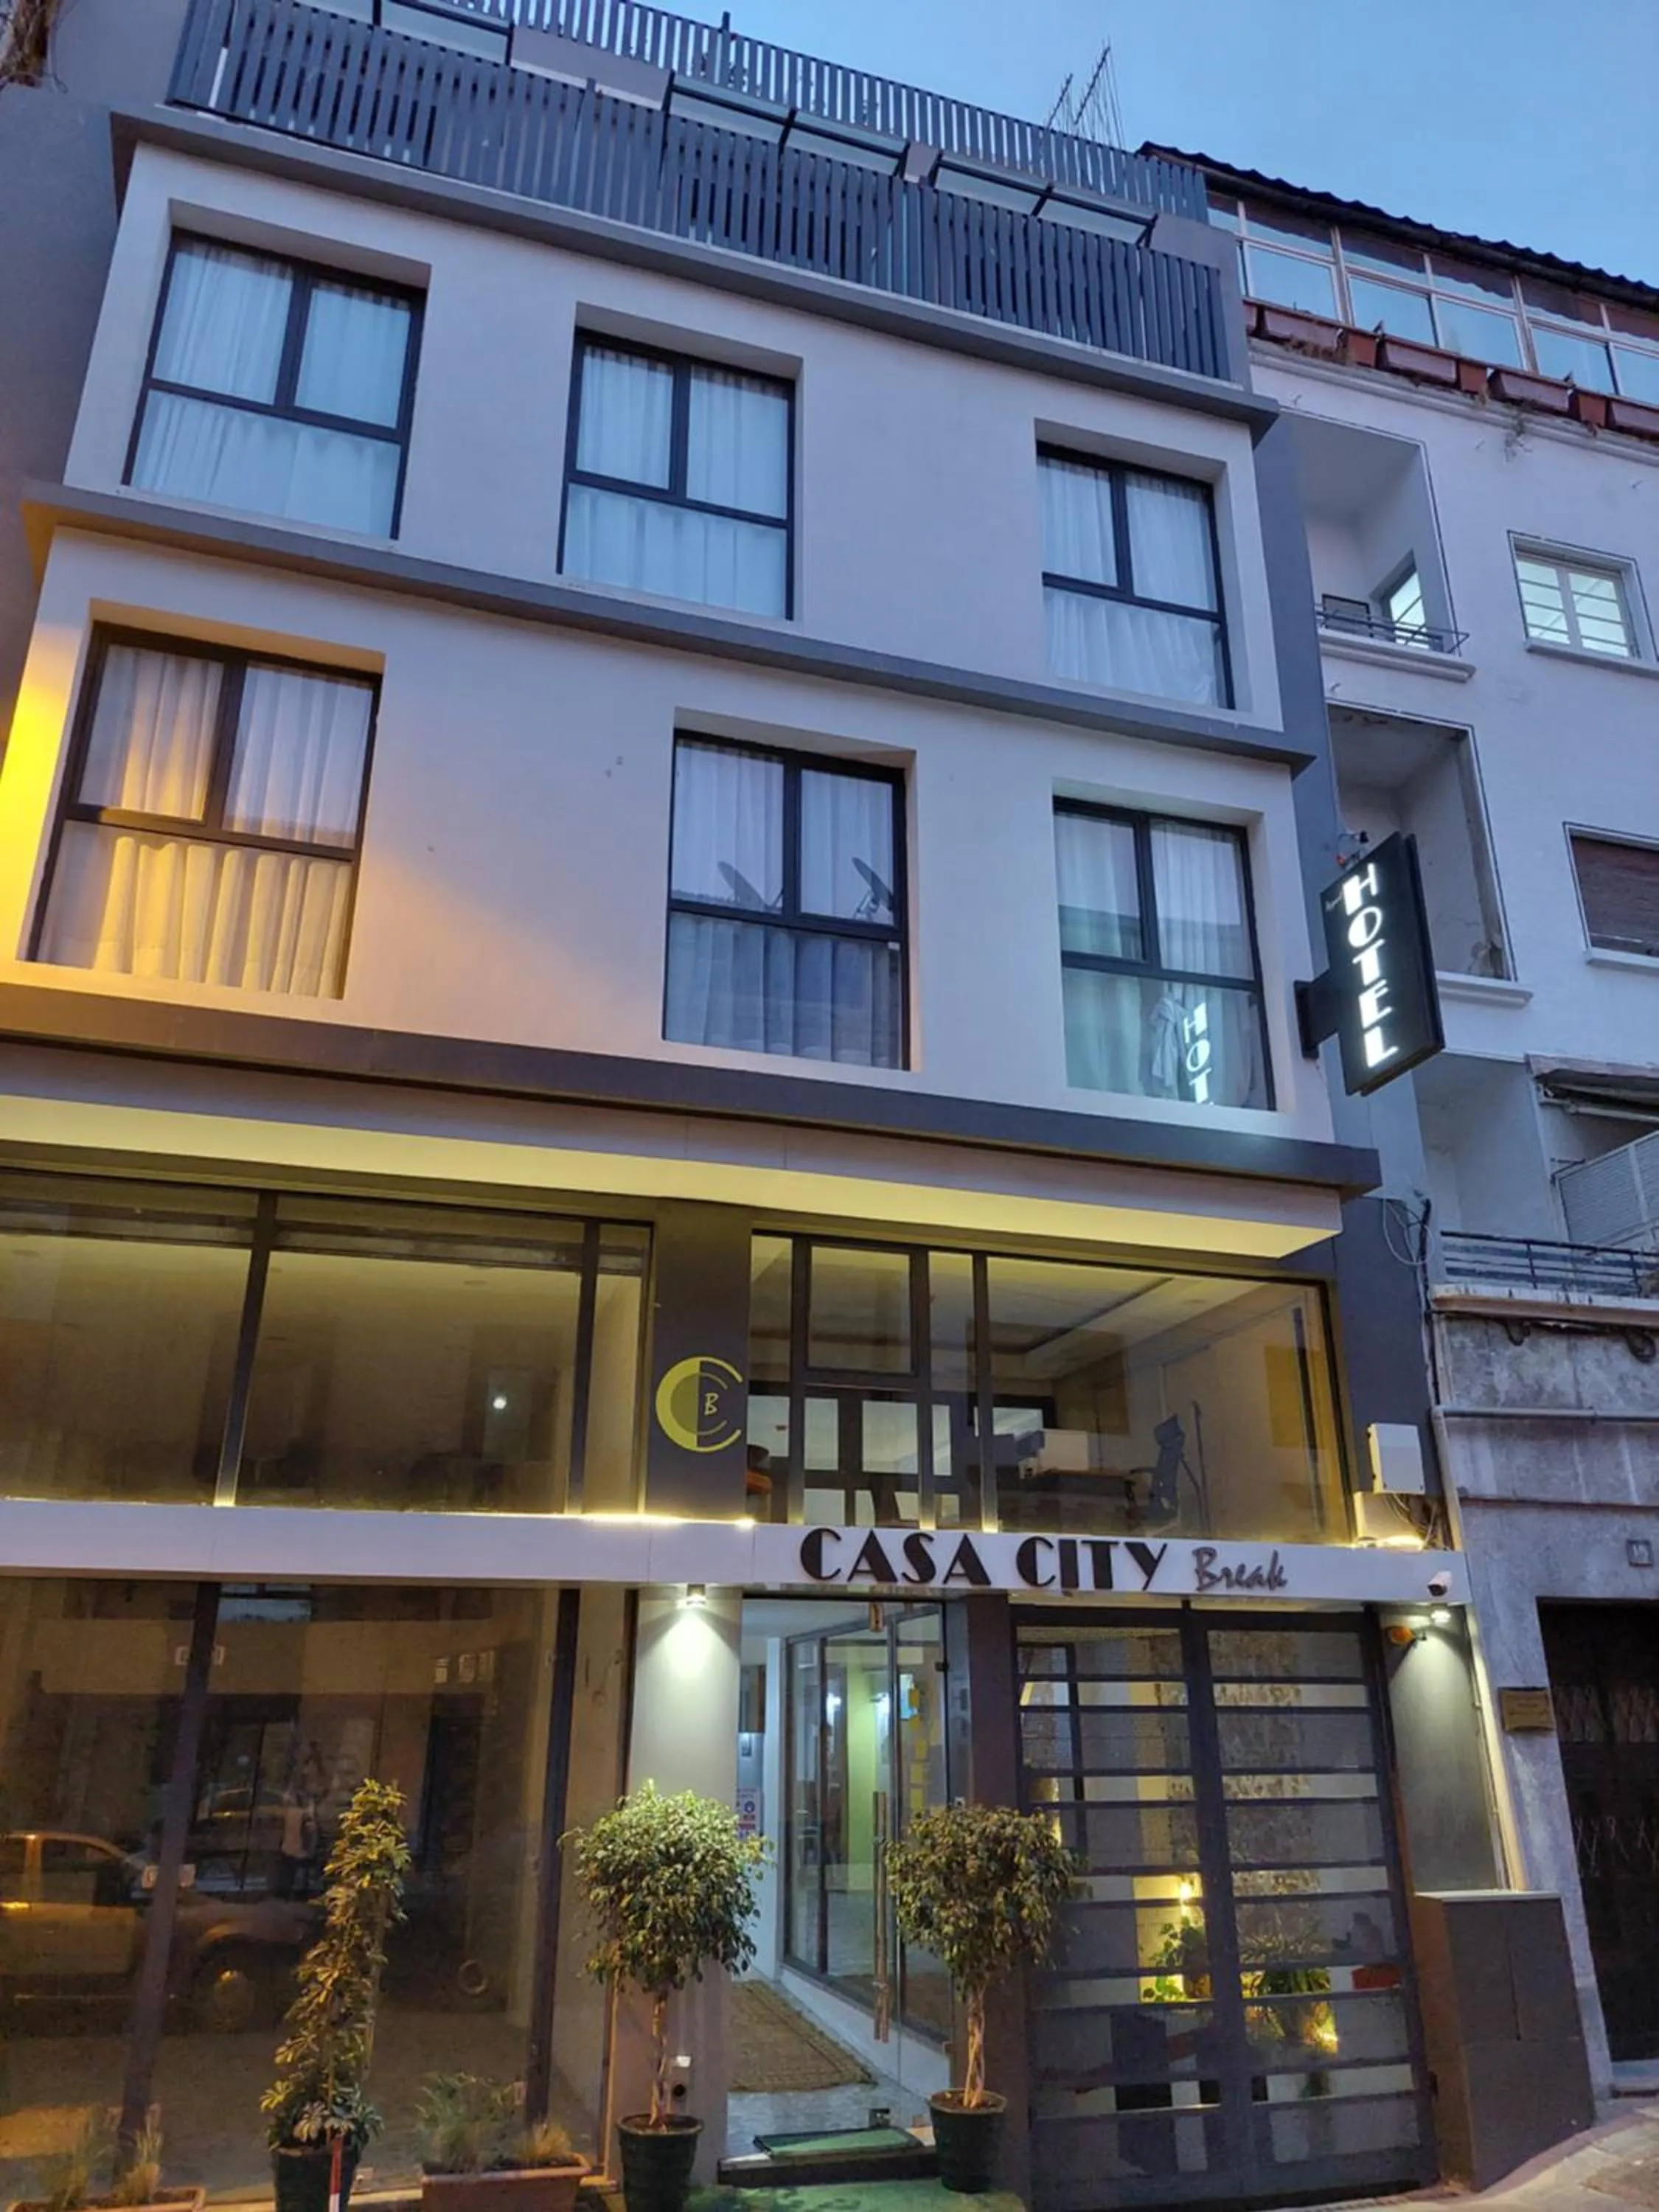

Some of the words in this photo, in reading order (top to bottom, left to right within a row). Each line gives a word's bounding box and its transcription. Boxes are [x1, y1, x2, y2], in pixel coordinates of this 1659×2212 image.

[1342, 863, 1399, 1068] HOTEL
[800, 1528, 991, 1586] CASA
[1015, 1536, 1167, 1591] CITY
[1192, 1547, 1288, 1592] Break
